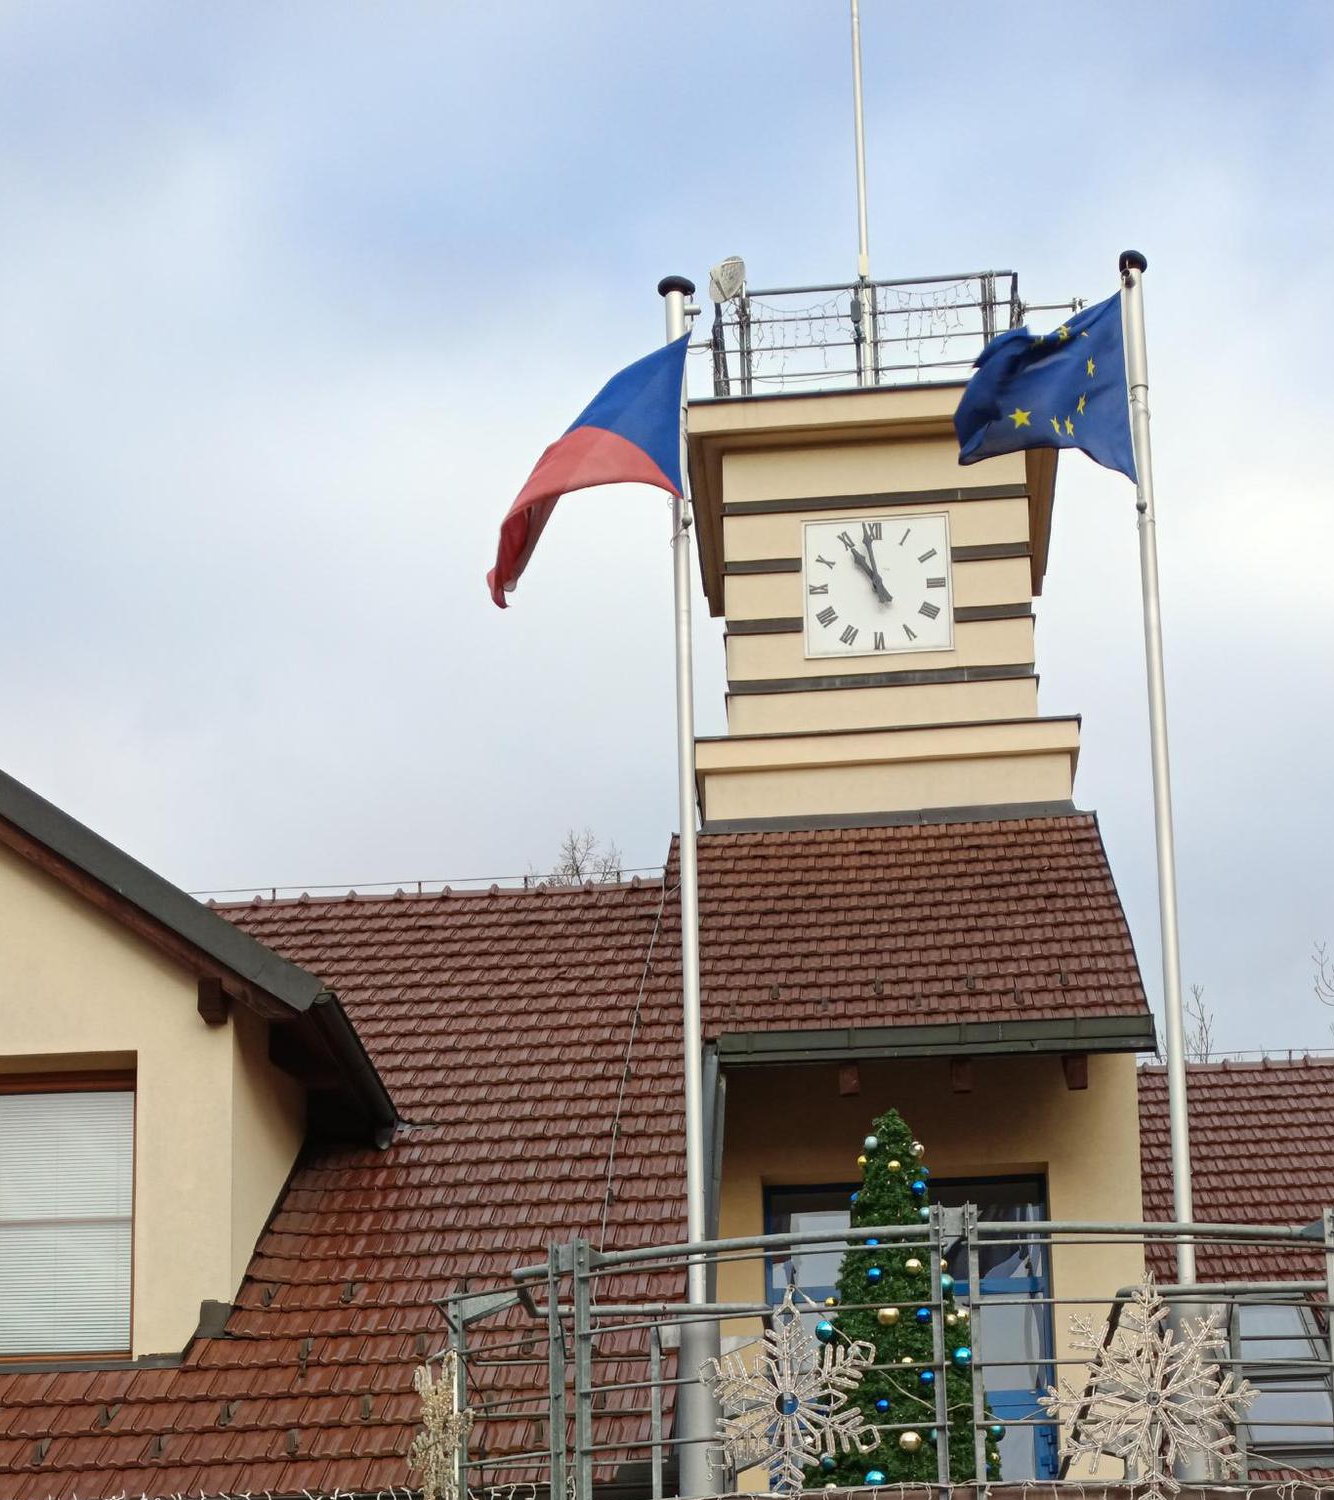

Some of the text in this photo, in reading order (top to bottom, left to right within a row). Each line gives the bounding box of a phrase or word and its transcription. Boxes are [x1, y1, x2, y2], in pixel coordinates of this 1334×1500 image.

[836, 531, 855, 551] XI
[815, 555, 836, 570] X
[918, 548, 938, 564] II
[809, 583, 829, 595] IX
[926, 577, 947, 589] III
[902, 623, 918, 641] V
